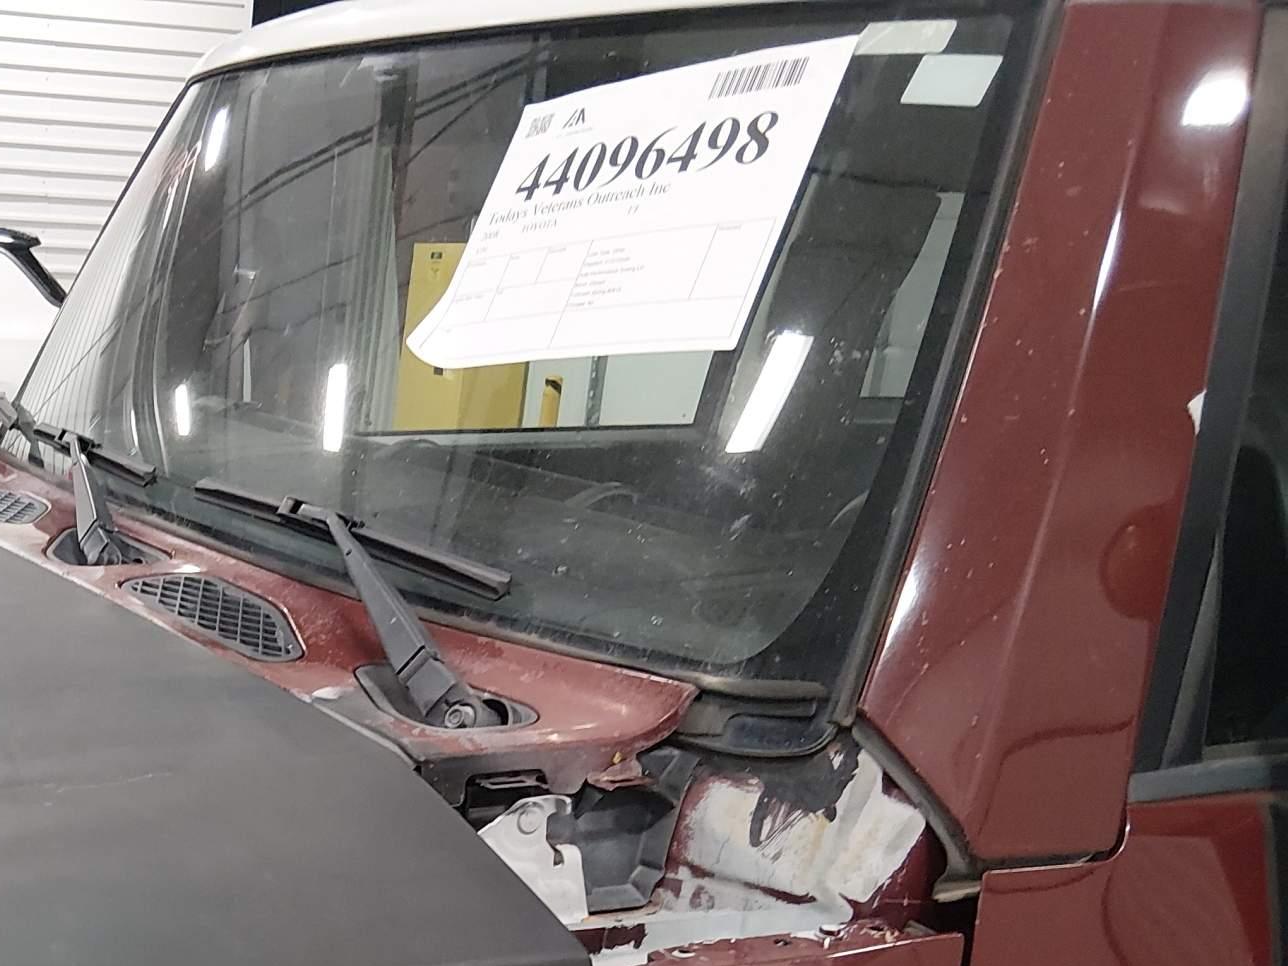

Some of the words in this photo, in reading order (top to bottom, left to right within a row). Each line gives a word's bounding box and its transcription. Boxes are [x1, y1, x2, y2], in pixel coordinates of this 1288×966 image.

[514, 110, 780, 201] 44096498
[488, 208, 527, 226] Todays
[533, 199, 583, 216] Veterans
[587, 184, 645, 206] Outreach
[648, 181, 672, 196] Inc
